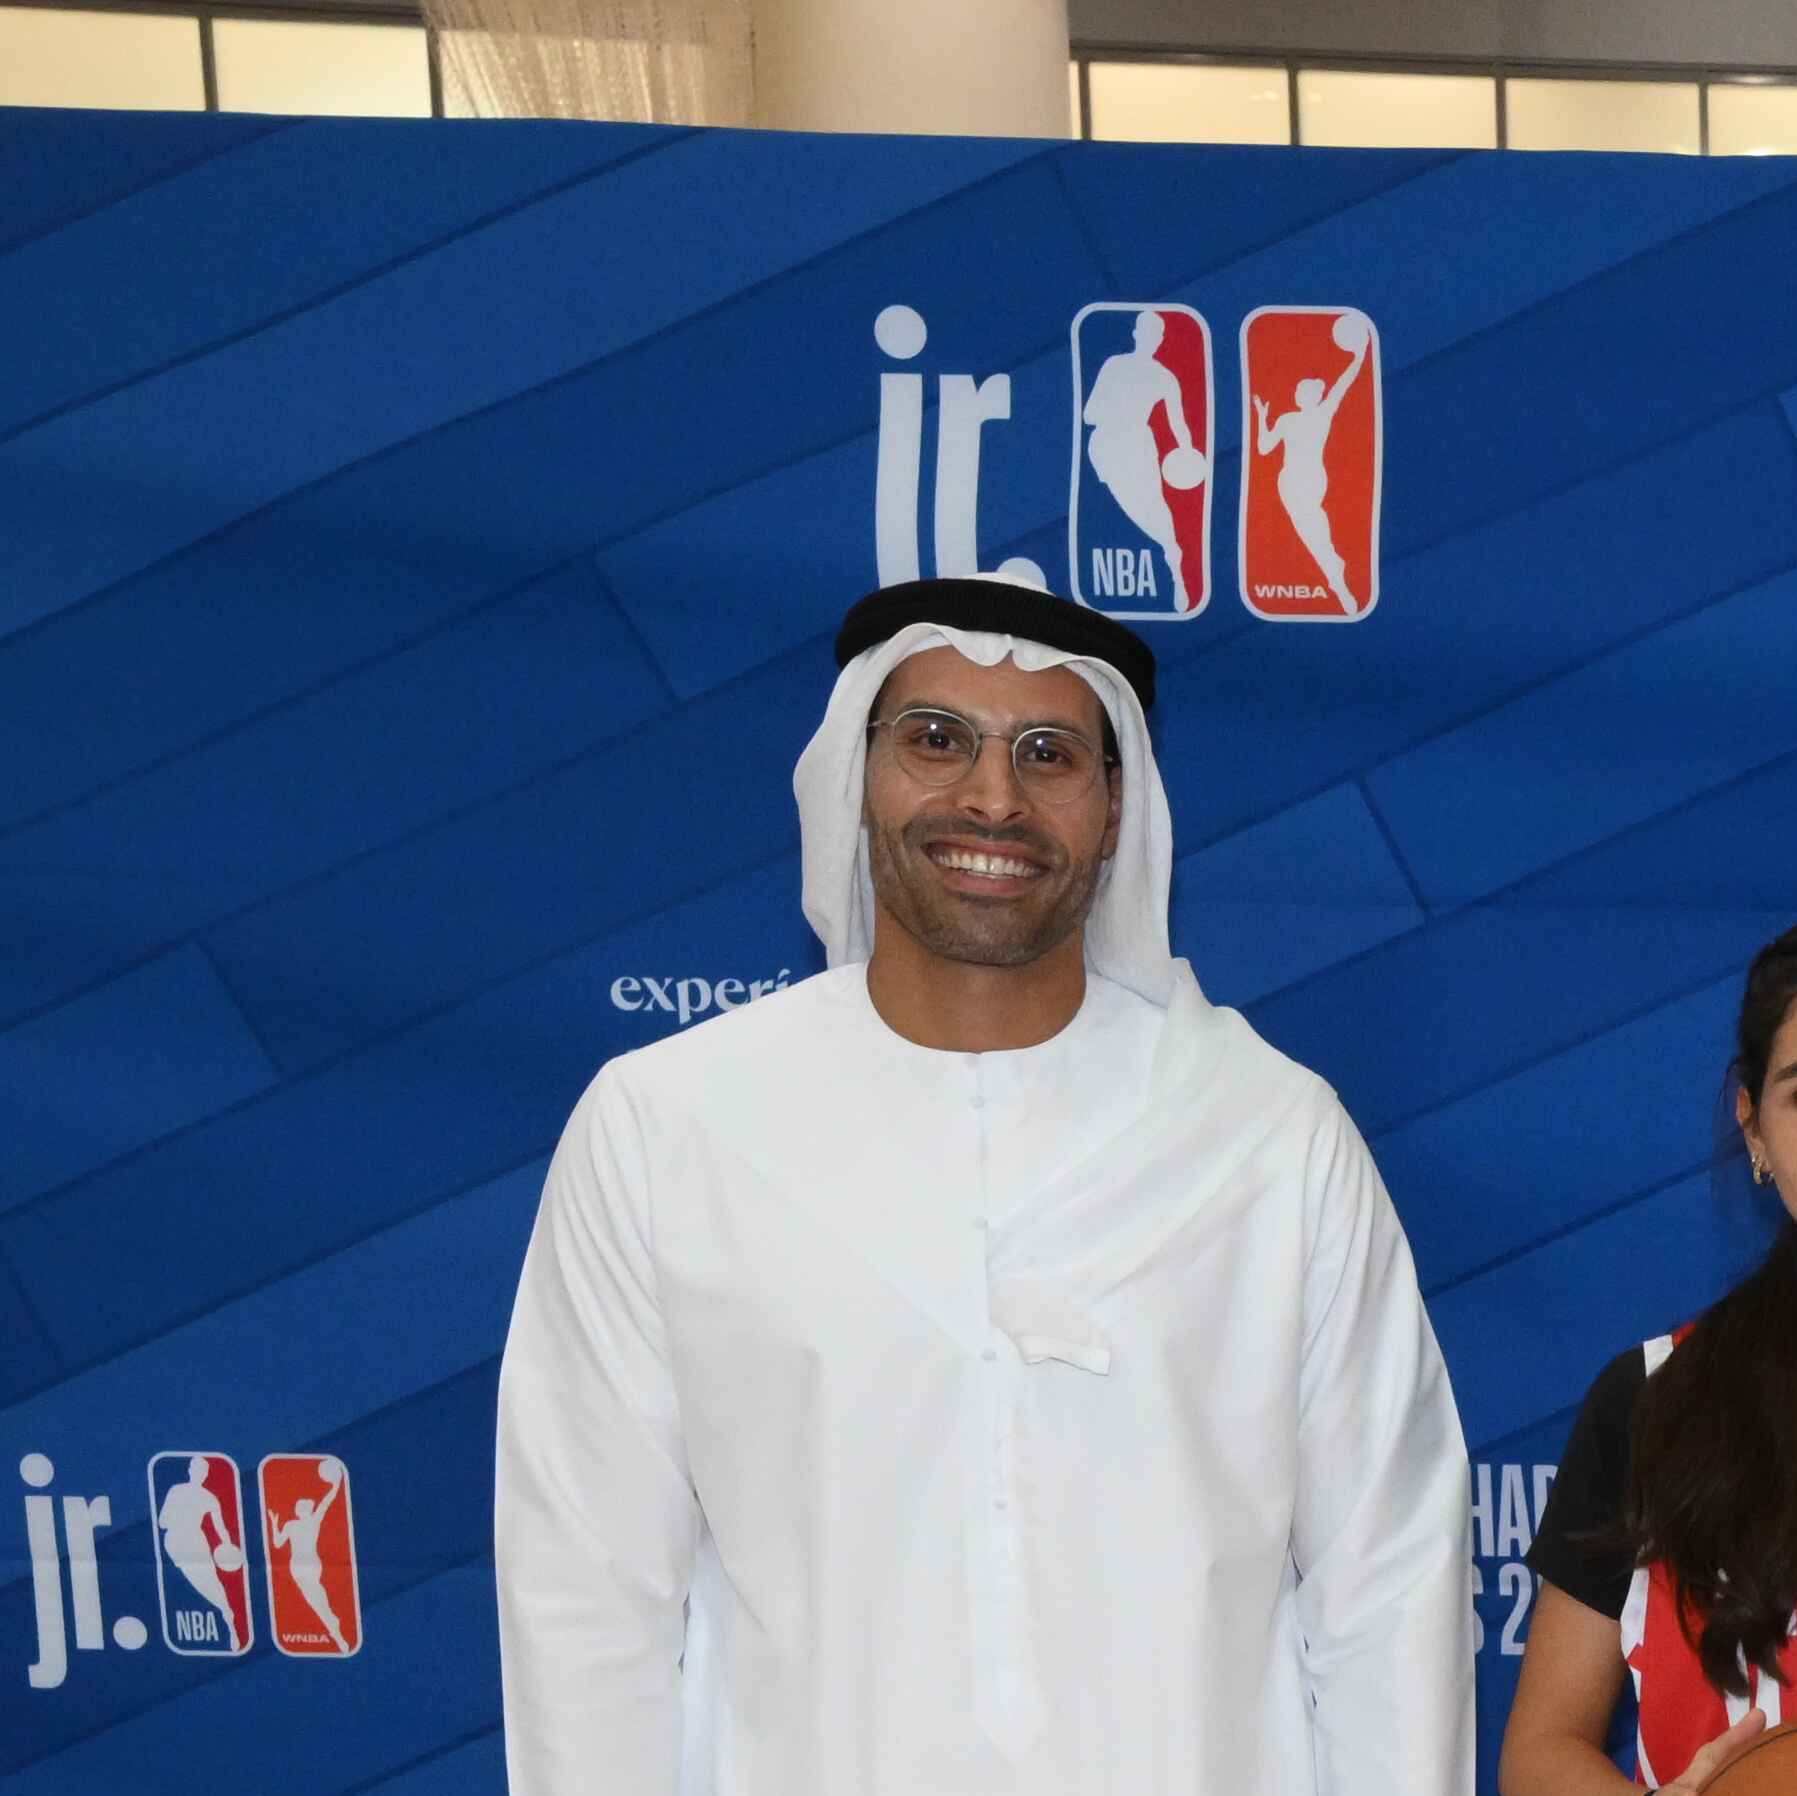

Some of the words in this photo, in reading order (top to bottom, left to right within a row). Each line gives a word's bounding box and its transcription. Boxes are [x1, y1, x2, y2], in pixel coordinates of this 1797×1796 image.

[874, 304, 1047, 590] jr.
[1092, 548, 1157, 597] NBA
[1254, 584, 1328, 599] WNBA
[19, 1452, 148, 1689] jr.
[175, 1610, 219, 1642] NBA
[281, 1632, 331, 1644] WNBA
